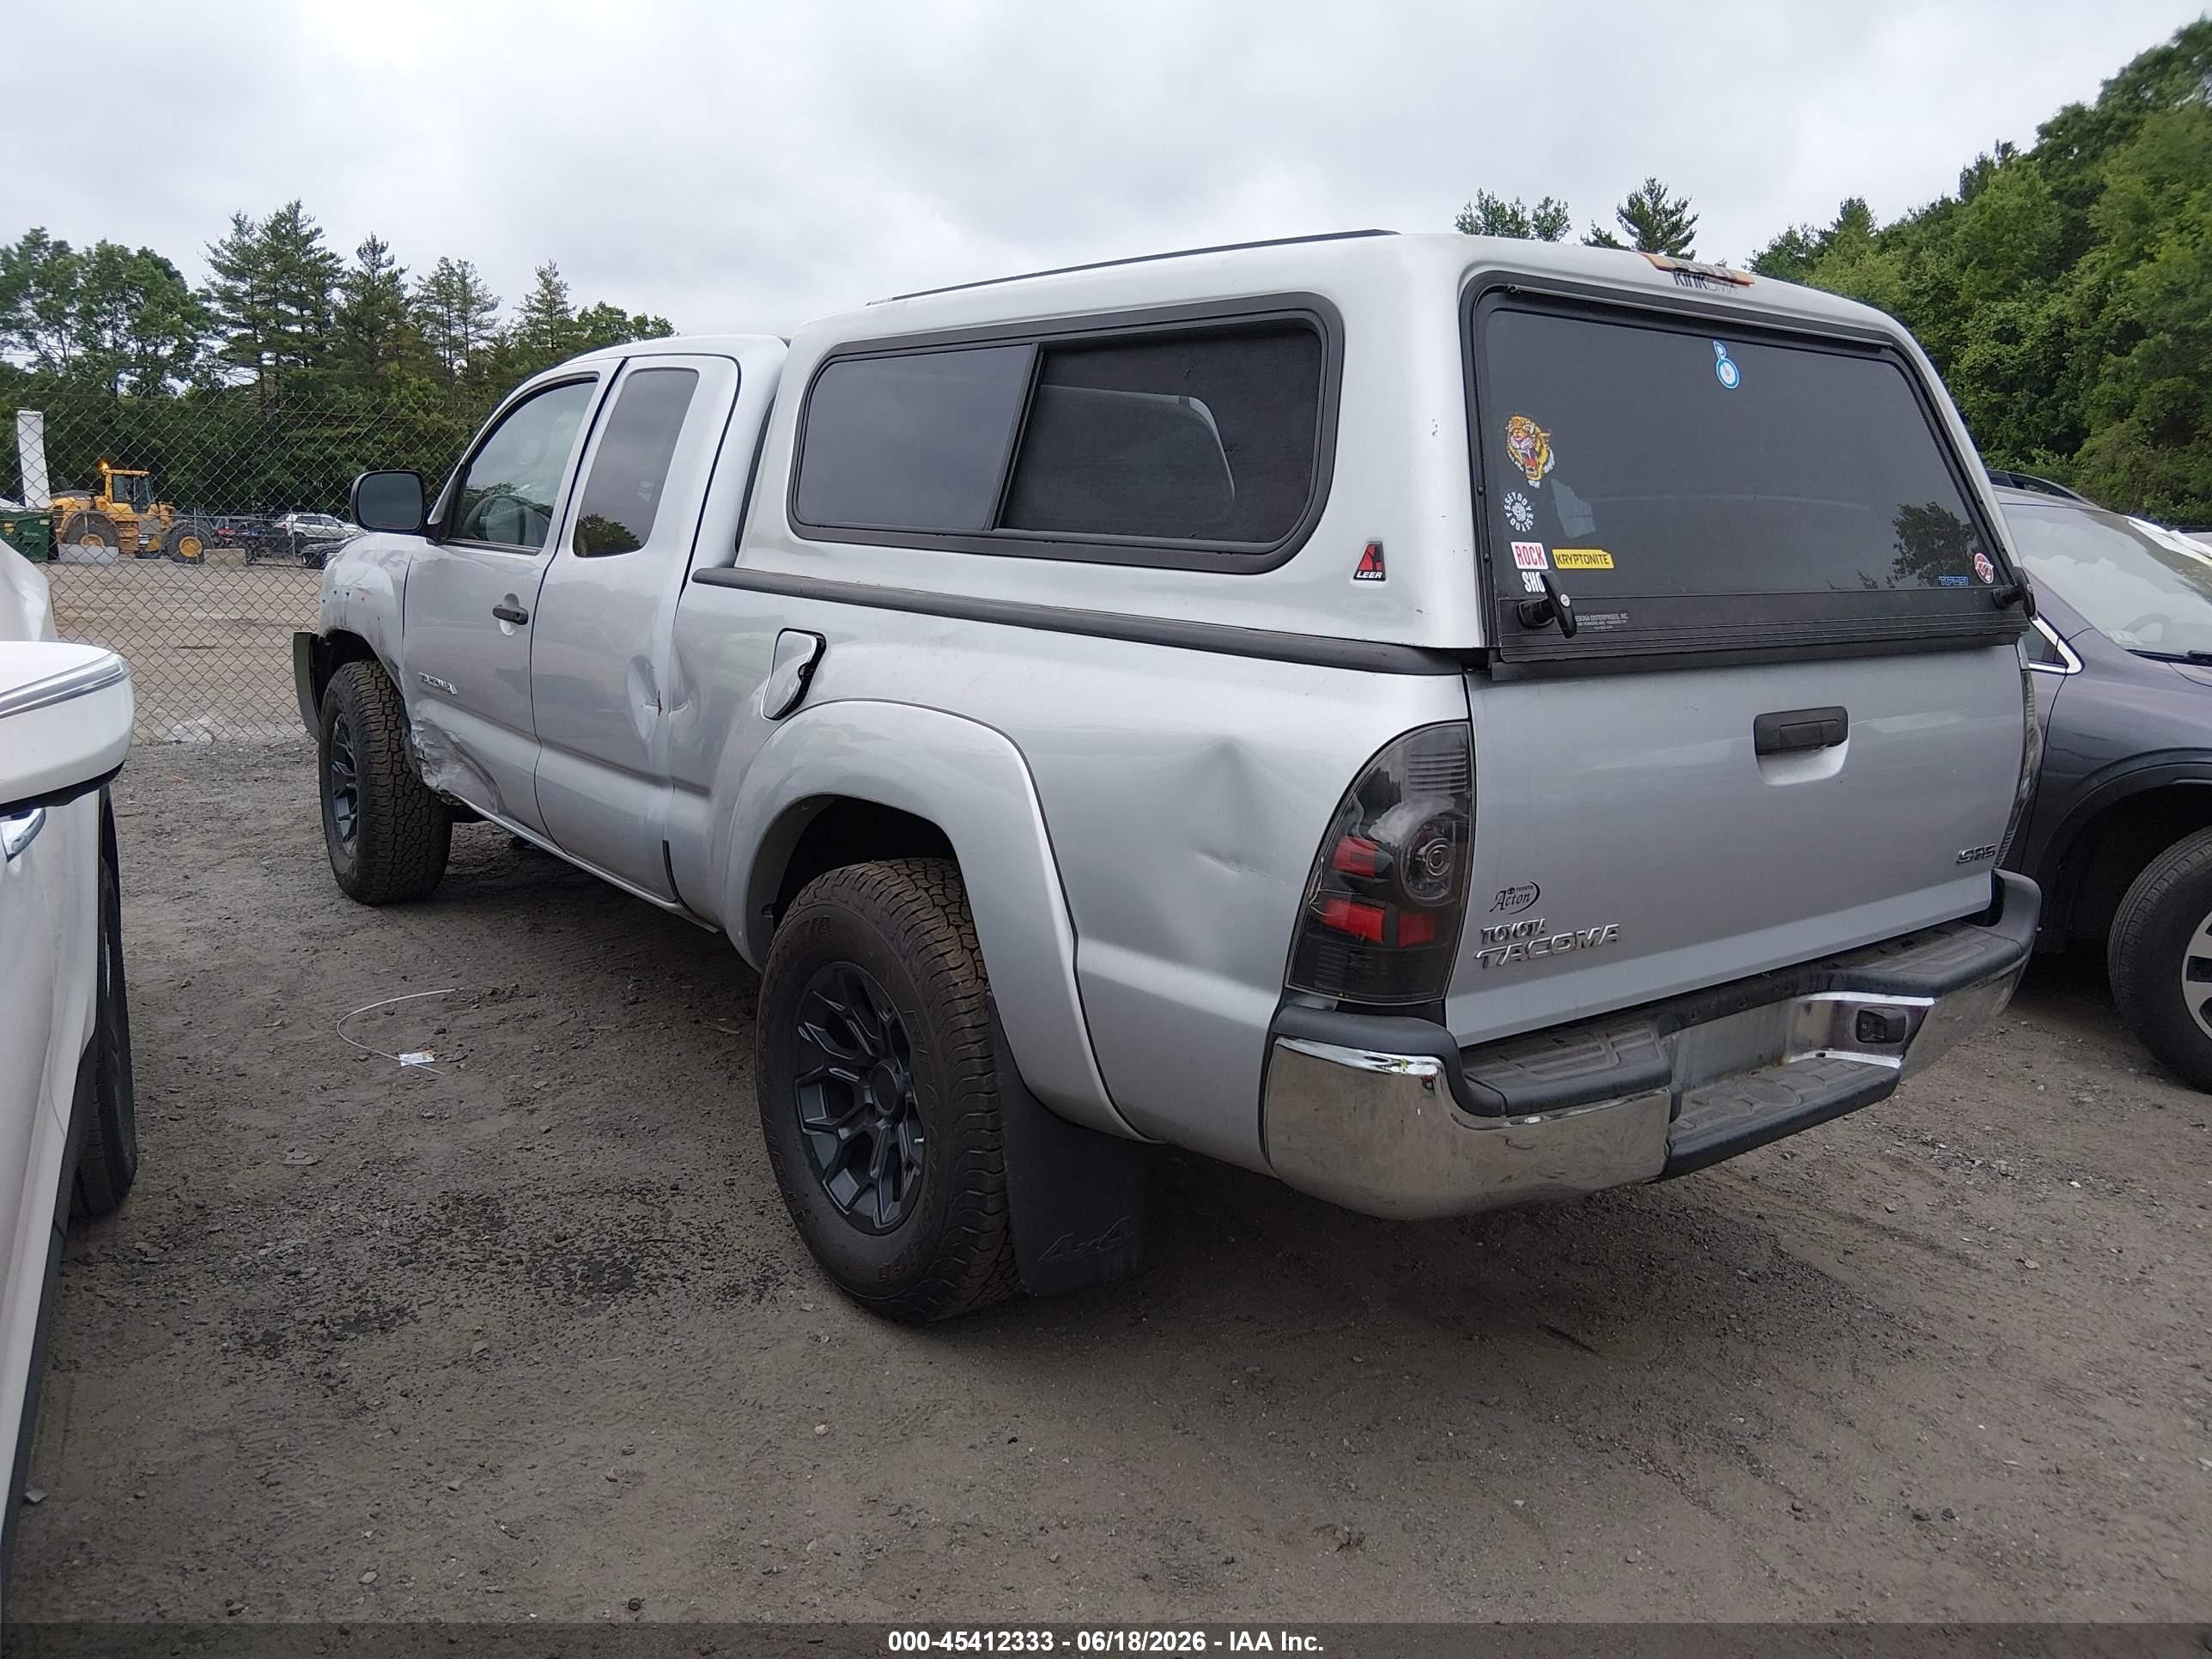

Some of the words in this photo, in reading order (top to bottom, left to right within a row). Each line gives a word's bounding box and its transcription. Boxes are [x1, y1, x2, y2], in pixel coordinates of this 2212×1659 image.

[1515, 545, 1546, 566] ROCK
[1555, 553, 1610, 566] KRYPTONITE
[1956, 843, 1997, 865] SR5
[1489, 890, 1530, 913] Acton
[1480, 918, 1546, 945] TOYOTA
[1474, 923, 1620, 969] TACOMA
